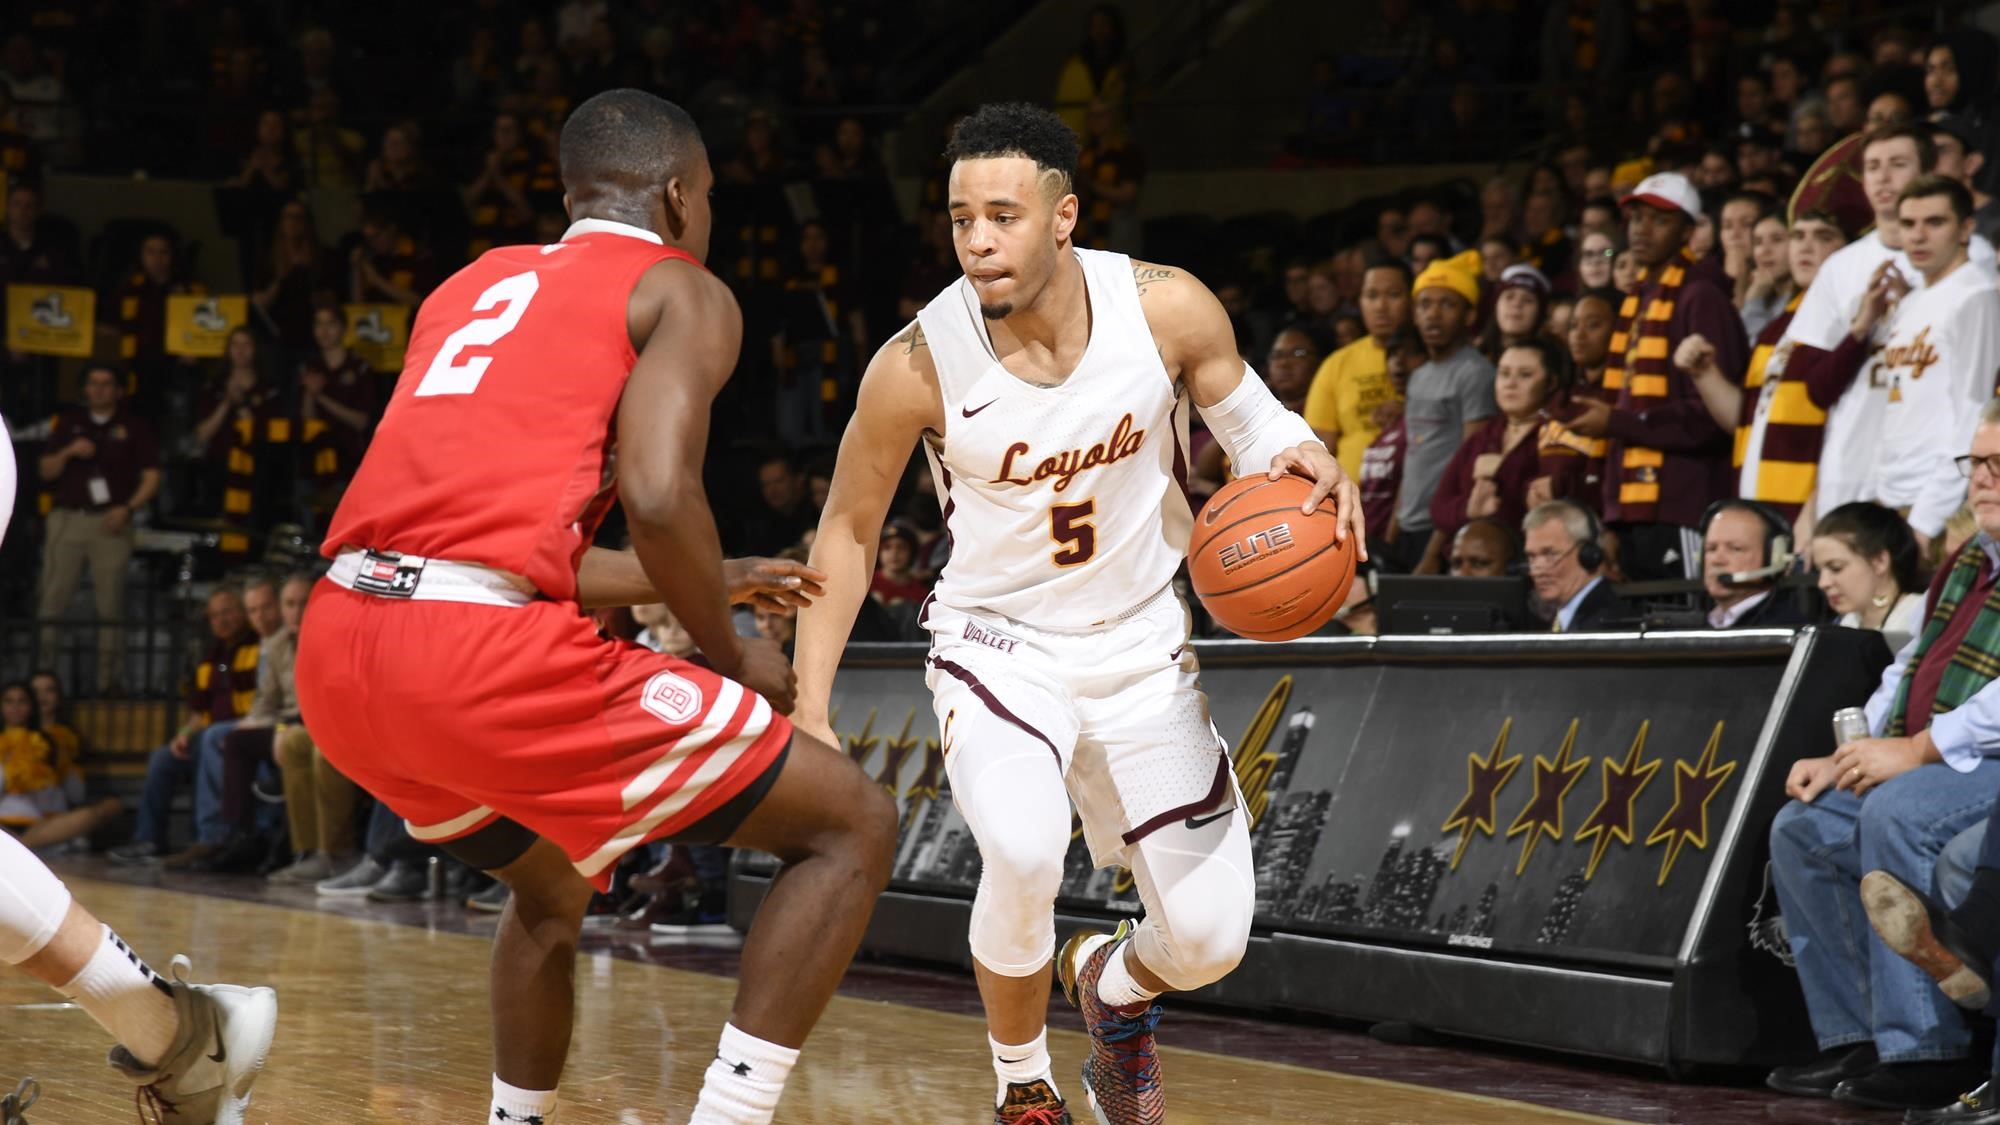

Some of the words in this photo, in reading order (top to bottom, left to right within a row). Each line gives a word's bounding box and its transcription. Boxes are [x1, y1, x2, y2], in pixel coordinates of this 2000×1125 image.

[413, 270, 540, 397] 2
[988, 412, 1146, 493] Loyola
[1049, 496, 1097, 568] 5
[1217, 522, 1294, 569] ELITE
[1224, 543, 1296, 576] CHAMPIONSHIP
[962, 618, 1021, 654] VALLEY
